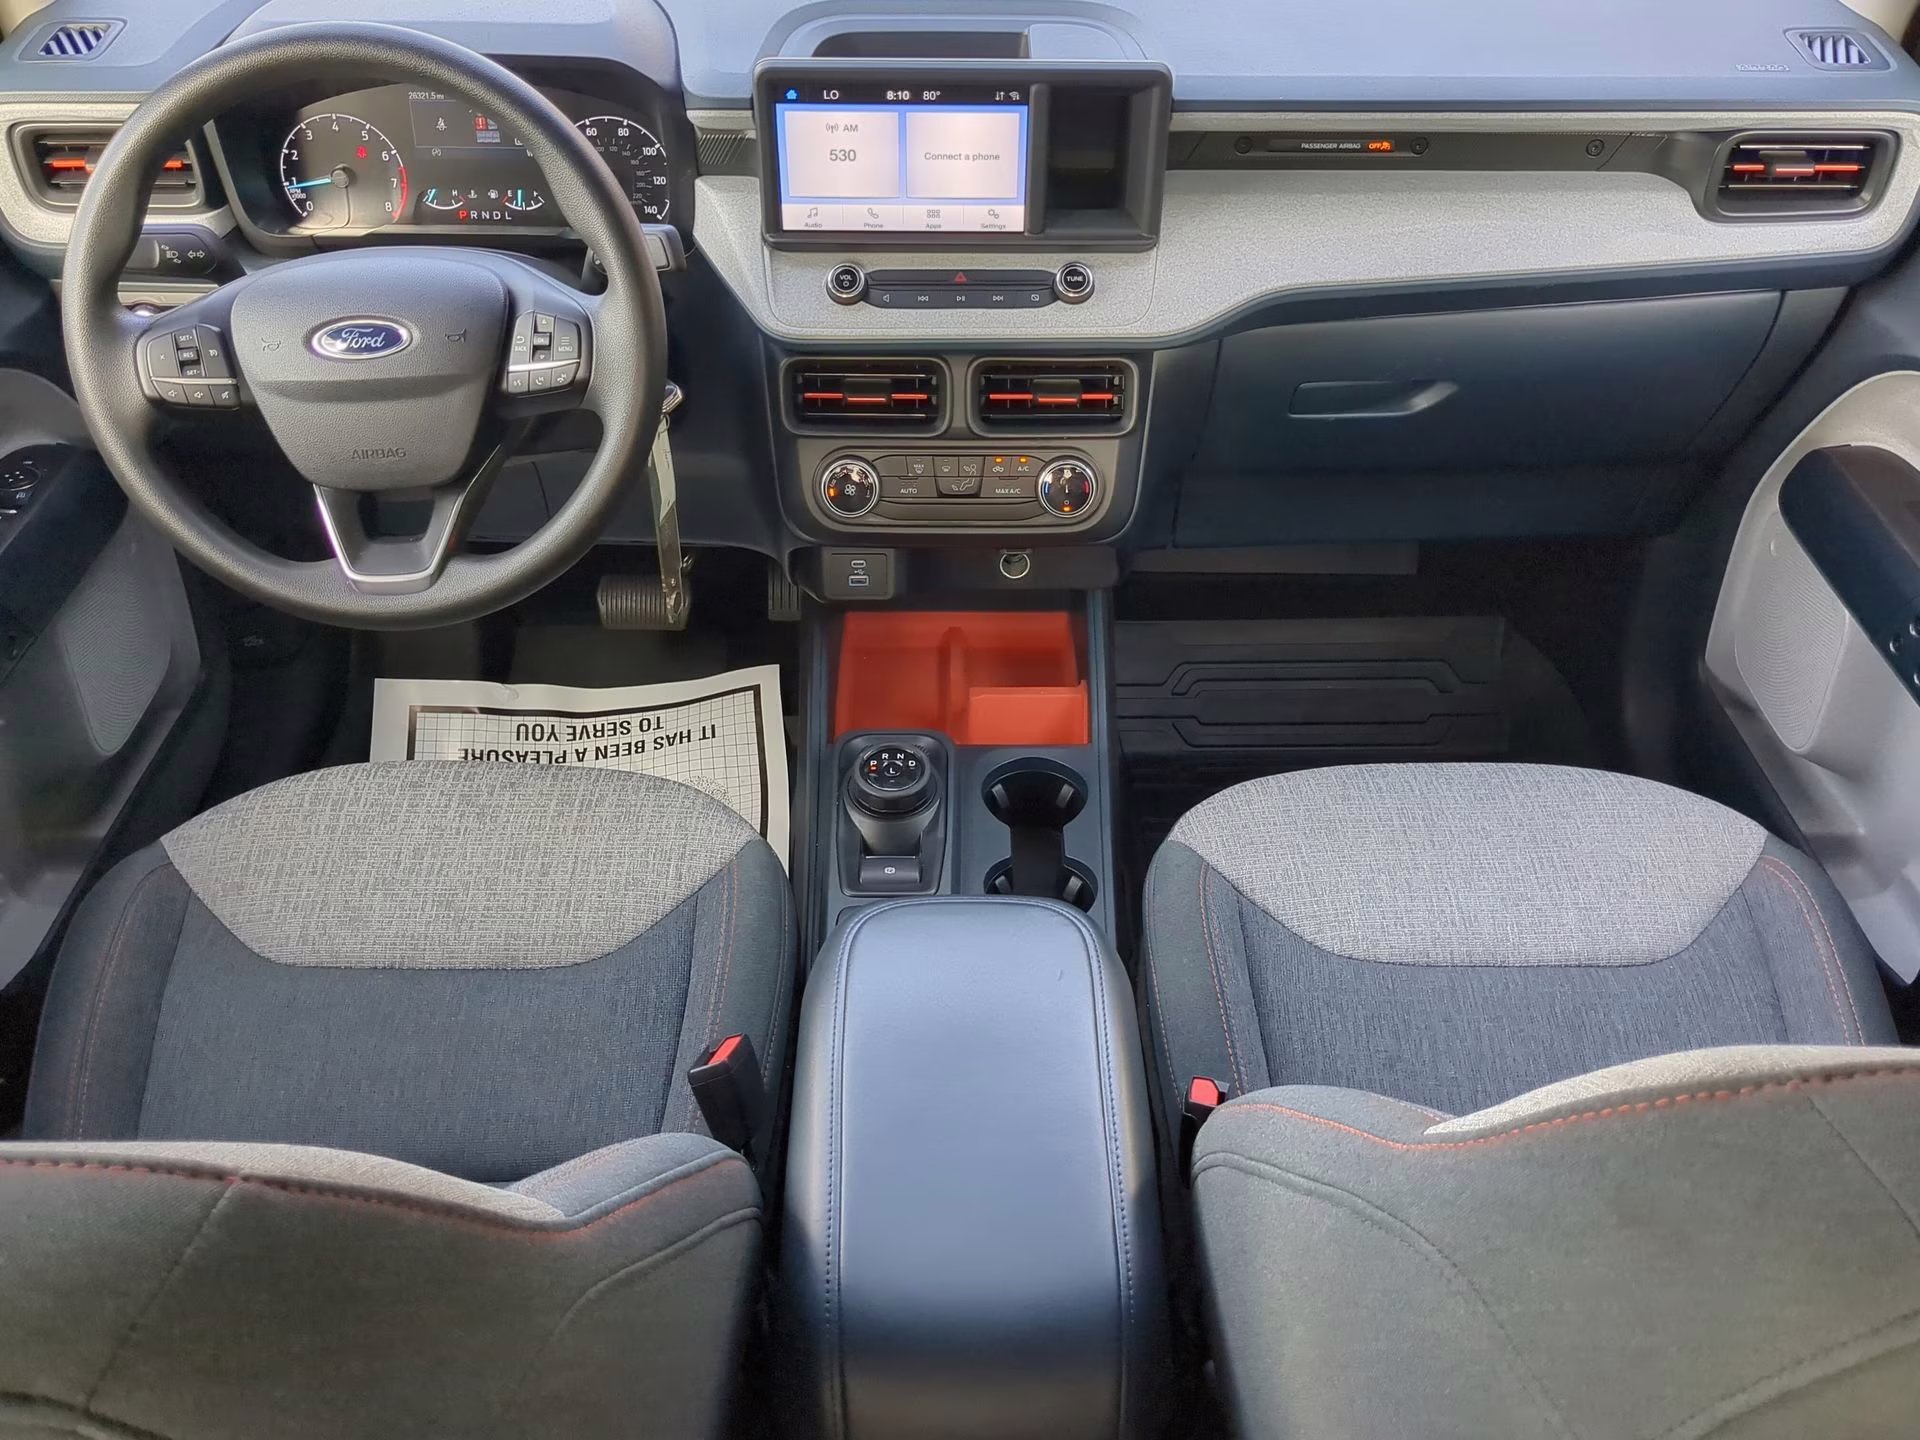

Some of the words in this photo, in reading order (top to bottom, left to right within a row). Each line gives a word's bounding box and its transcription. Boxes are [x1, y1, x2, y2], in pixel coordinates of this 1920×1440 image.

[823, 89, 839, 100] LO
[886, 90, 910, 101] 8:10
[332, 121, 339, 131] 4
[843, 124, 858, 133] AM
[305, 129, 313, 140] 3
[361, 130, 369, 141] 5
[586, 128, 597, 136] 60
[618, 128, 629, 136] 80
[1301, 142, 1337, 150] PASSENGER
[291, 150, 299, 160] 2
[381, 151, 389, 161] 6
[642, 147, 657, 156] 100
[829, 149, 857, 161] 530
[924, 152, 962, 161] Connect
[972, 152, 1000, 162] phone
[390, 178, 398, 188] 7
[652, 176, 667, 185] 120
[507, 189, 513, 197] E
[305, 201, 314, 211] 0
[384, 201, 392, 212] 8
[643, 205, 658, 214] 140
[470, 211, 478, 219] R
[481, 211, 490, 219] N
[493, 211, 501, 220] D
[505, 211, 512, 220] L
[925, 223, 942, 231] Apps
[337, 327, 386, 350] Ford
[351, 448, 407, 460] AIRBAG
[638, 715, 664, 733] TO
[516, 723, 559, 741] YOU
[566, 720, 632, 742] SERVE
[698, 723, 716, 741] IT
[653, 728, 692, 751] HAS
[574, 747, 588, 762] A
[595, 739, 646, 761] BEEN
[458, 748, 567, 765] PLEASURE
